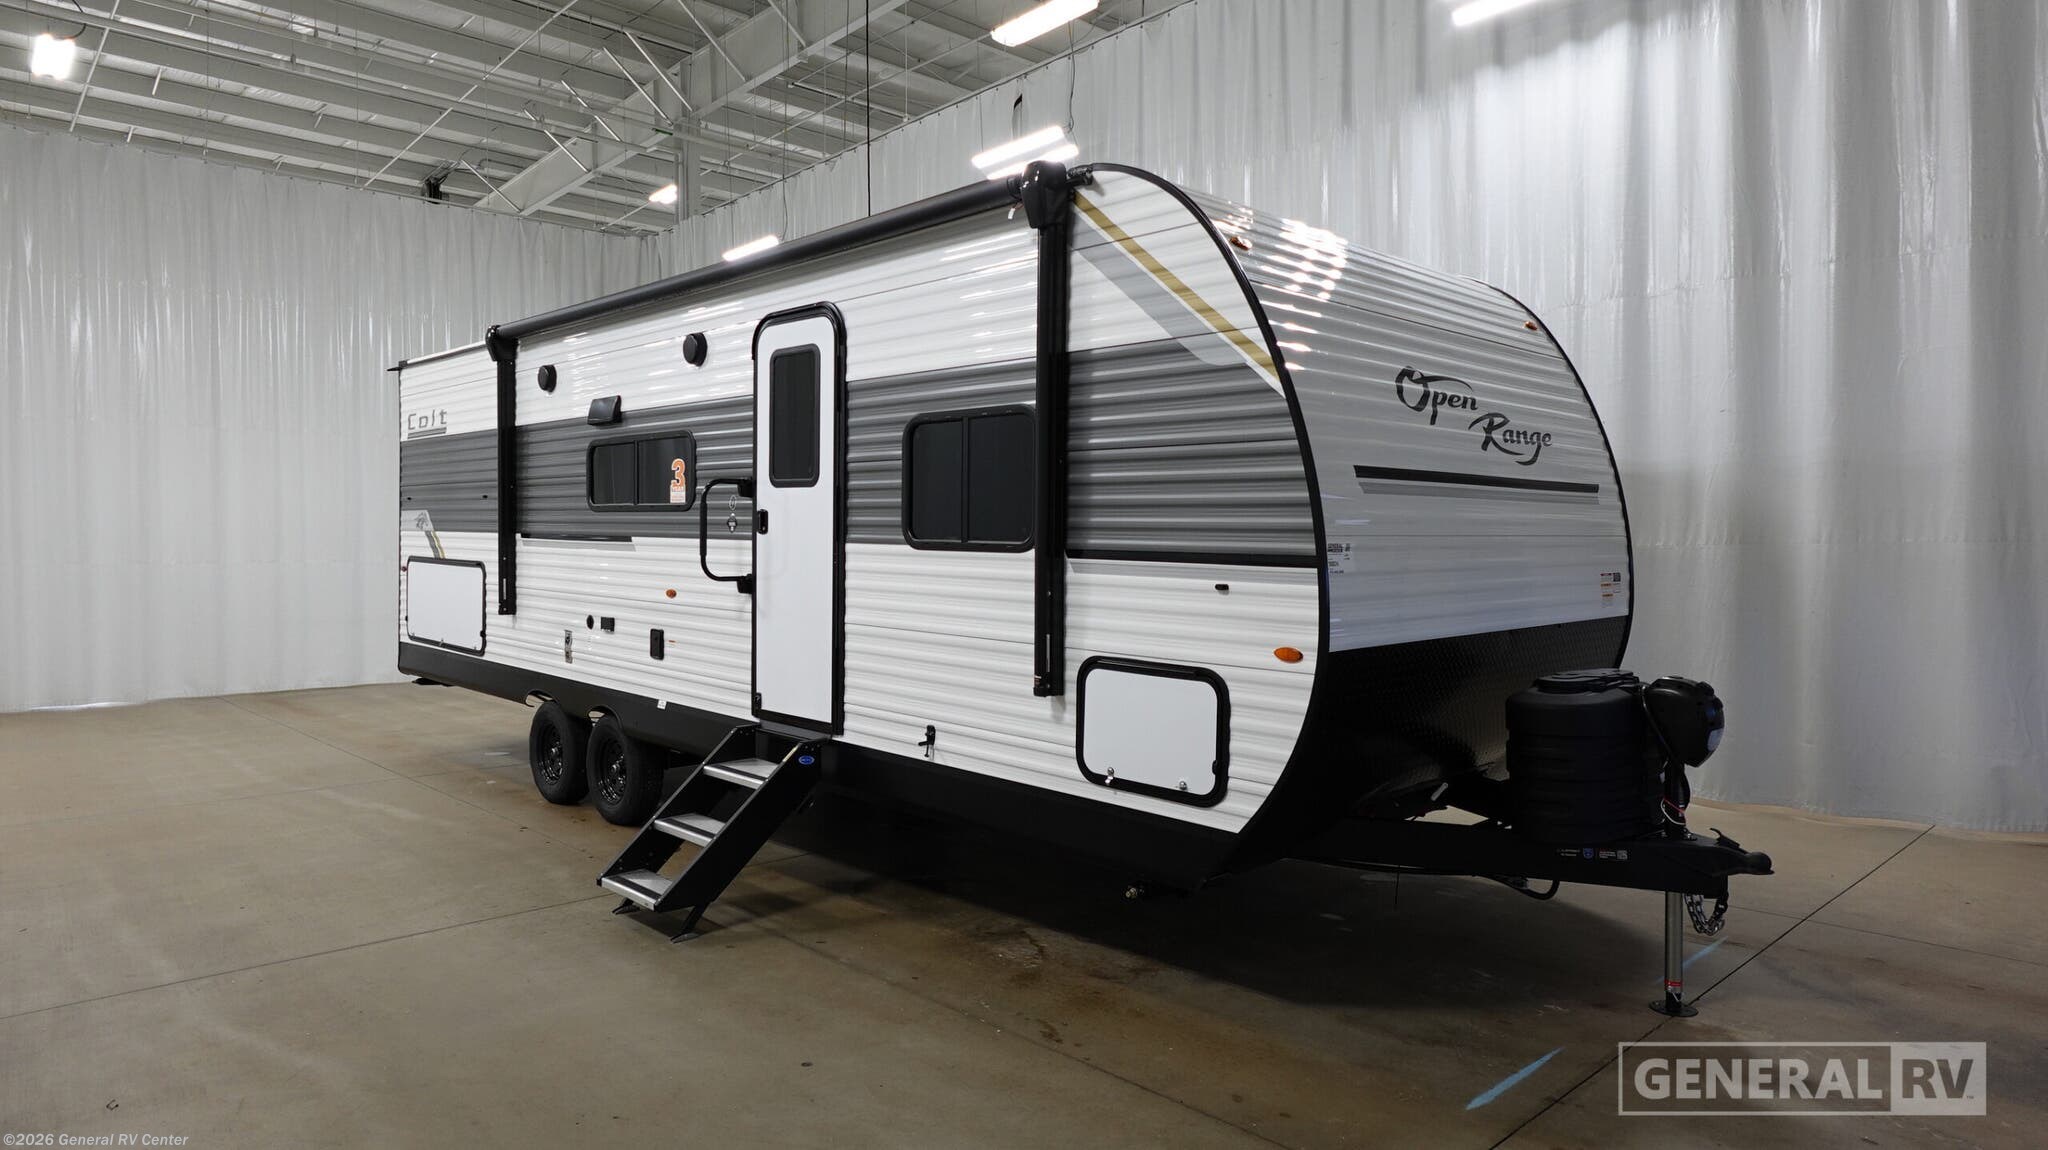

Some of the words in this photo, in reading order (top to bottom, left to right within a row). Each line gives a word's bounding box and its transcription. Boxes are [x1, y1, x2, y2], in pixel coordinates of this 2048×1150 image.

[1394, 366, 1478, 425] Open
[408, 409, 447, 430] Colt
[1468, 412, 1552, 465] Range
[671, 458, 686, 487] 3
